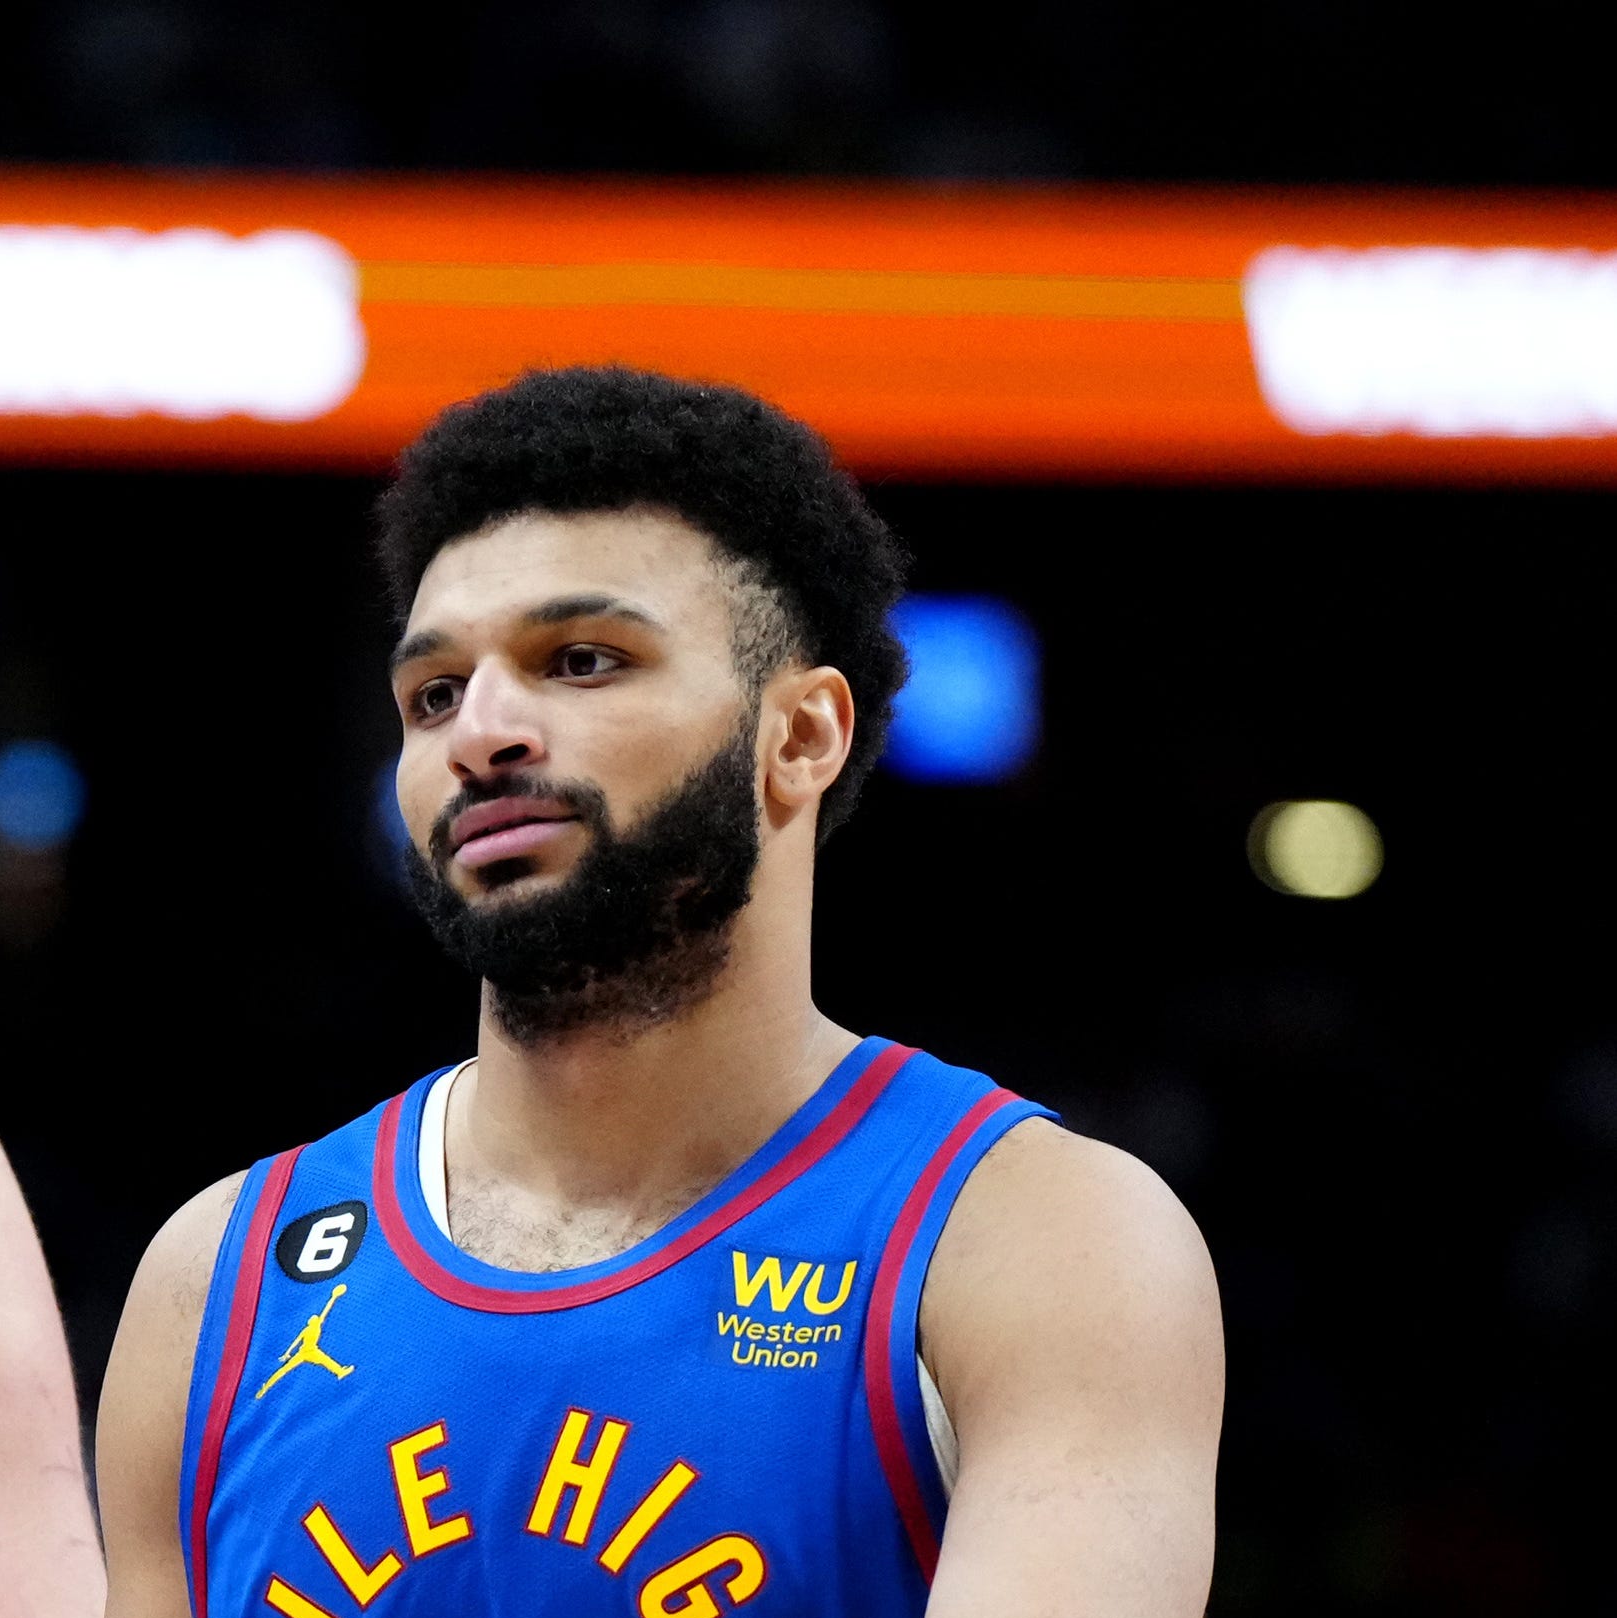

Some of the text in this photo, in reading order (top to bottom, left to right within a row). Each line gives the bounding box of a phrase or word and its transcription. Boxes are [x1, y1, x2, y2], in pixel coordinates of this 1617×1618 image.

[296, 1212, 355, 1273] 6
[732, 1250, 858, 1315] WU
[717, 1311, 842, 1343] Western
[732, 1340, 818, 1368] Union
